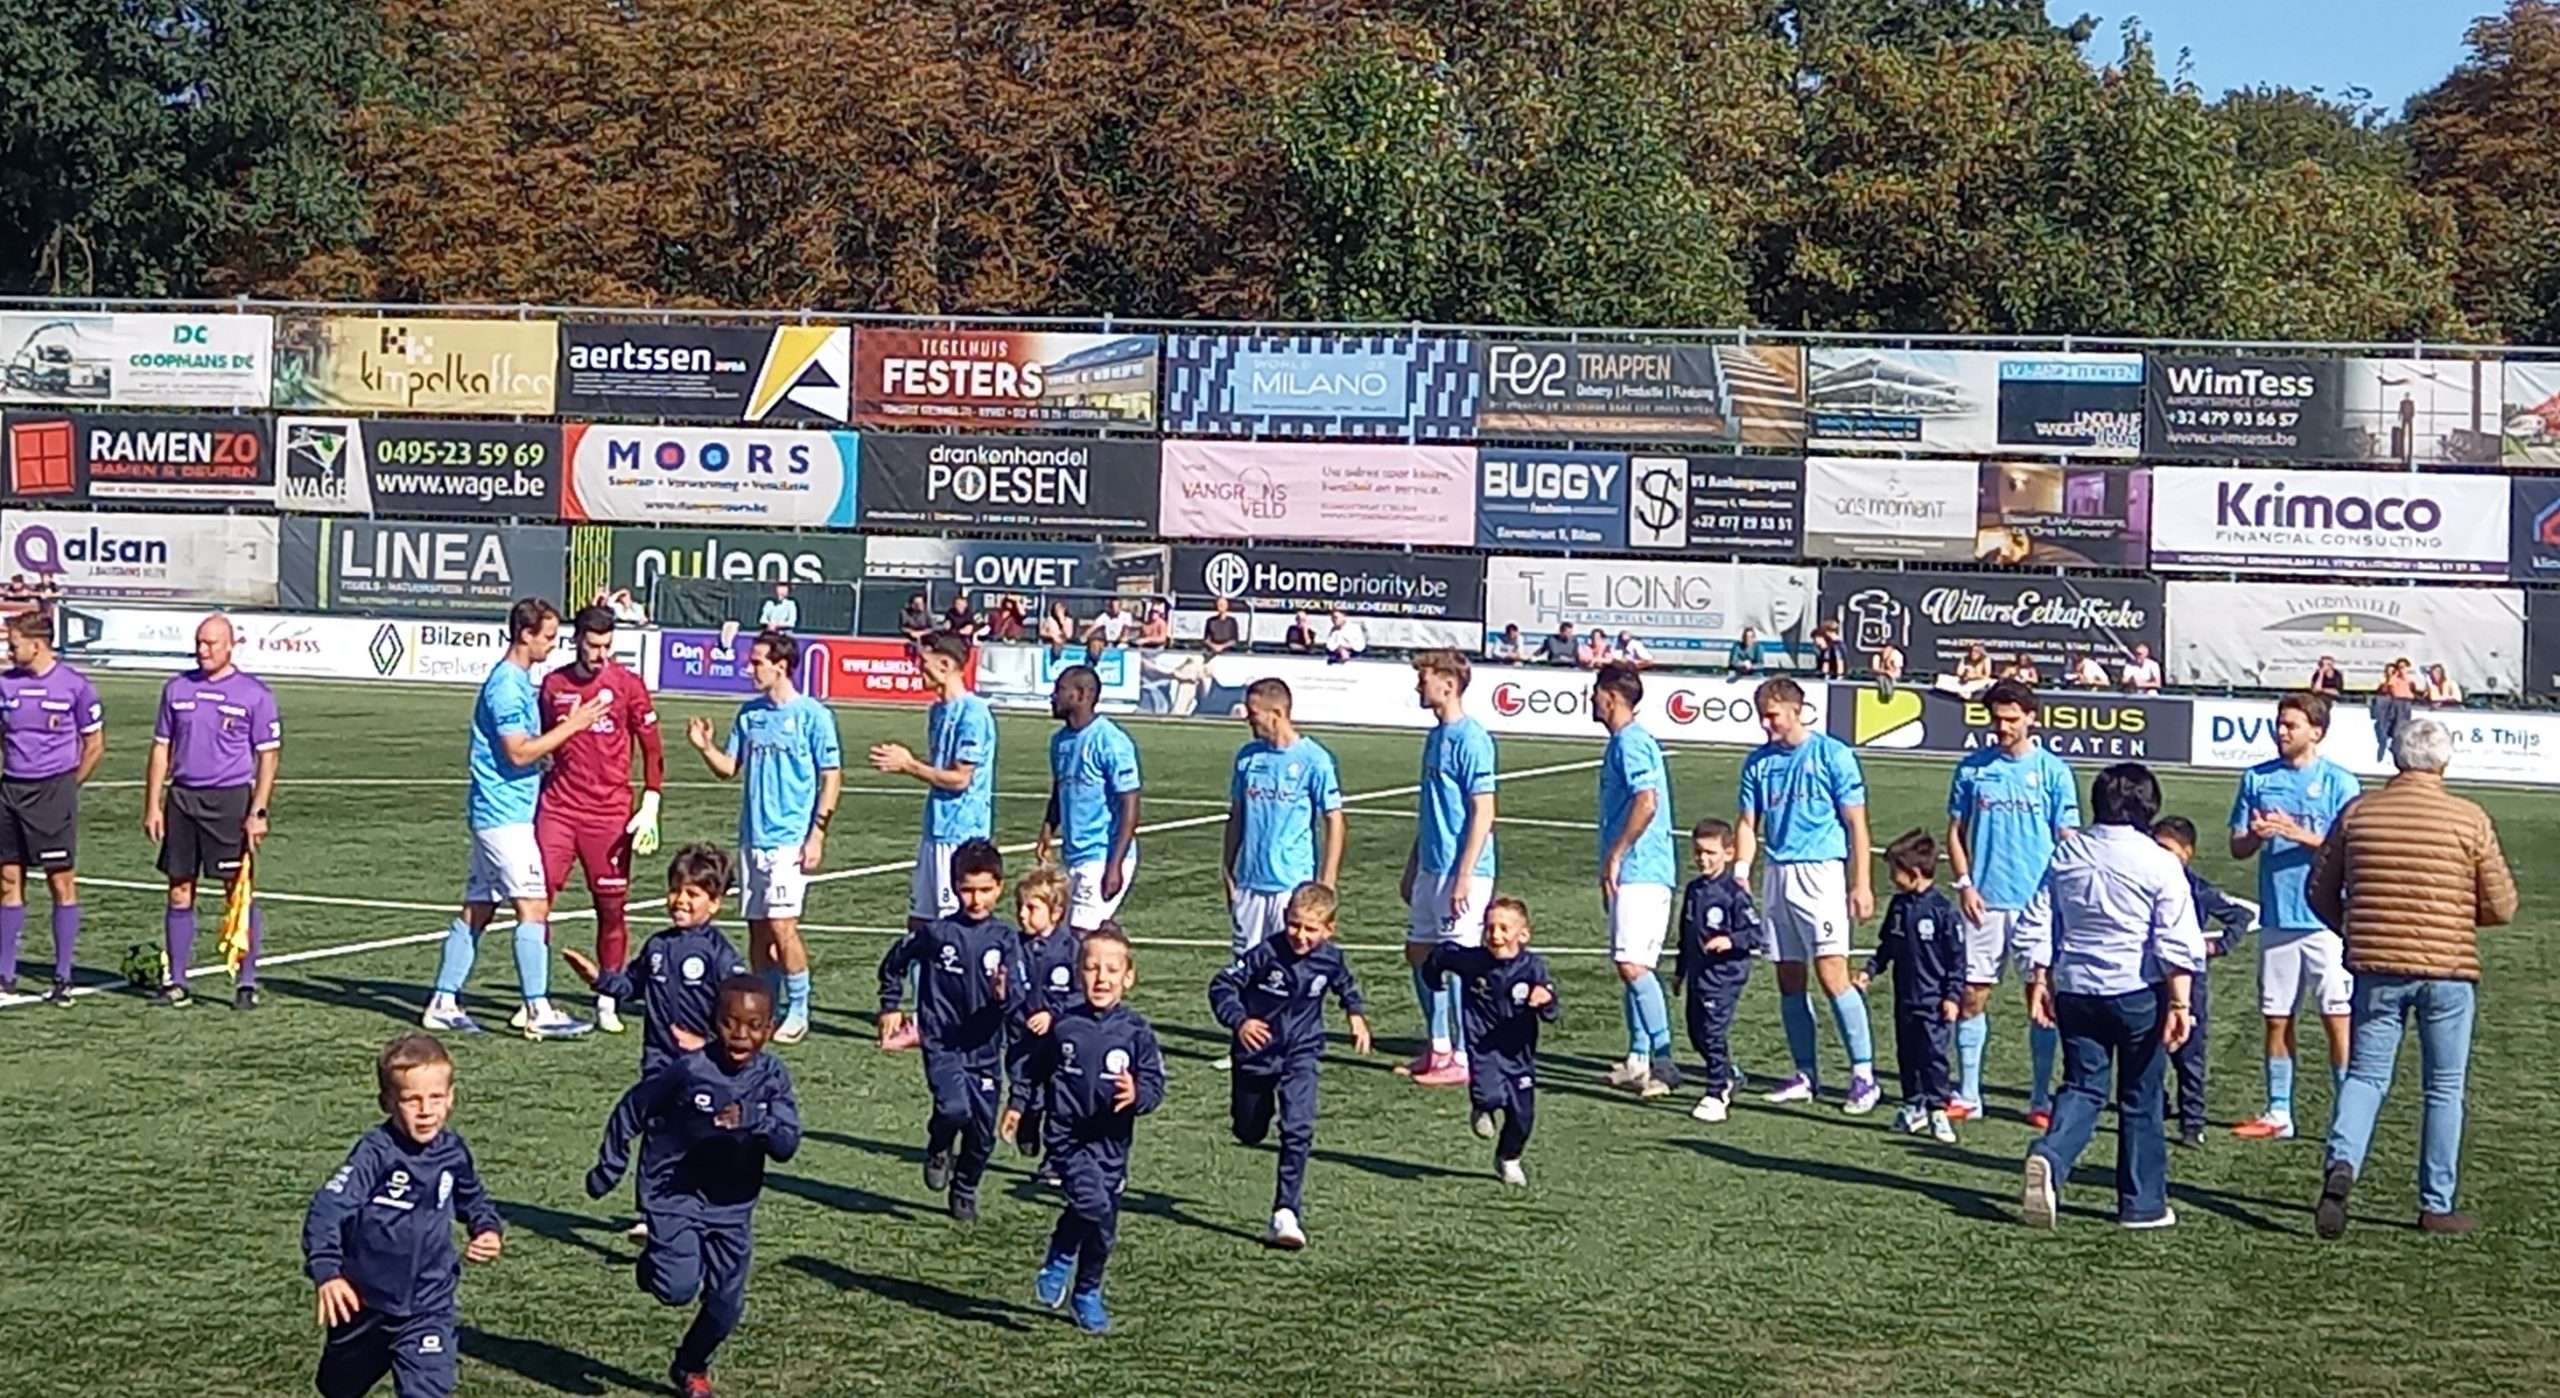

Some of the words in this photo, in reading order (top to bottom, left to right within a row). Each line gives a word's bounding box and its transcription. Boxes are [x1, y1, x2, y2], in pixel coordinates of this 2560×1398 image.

[174, 325, 208, 344] DC
[921, 338, 1009, 358] TEGELHUIS
[130, 354, 228, 369] COOPMANS
[569, 342, 711, 372] aertssen
[1577, 353, 1672, 381] TRAPPEN
[882, 358, 1045, 398] FESTERS
[1253, 371, 1388, 397] MILANO
[2167, 366, 2315, 397] WimTess
[2199, 411, 2231, 426] 479
[2233, 412, 2253, 427] 93
[90, 430, 260, 465] RAMENZO
[377, 440, 472, 466] 0495-23
[477, 443, 508, 466] 59
[513, 444, 545, 467] 69
[607, 440, 810, 474] MOORS
[929, 444, 1088, 466] drankenhandel
[90, 463, 156, 478] RAMEN
[181, 465, 257, 479] DEUREN
[376, 470, 545, 501] www.wage.be
[928, 465, 1088, 505] POESEN
[1484, 461, 1619, 501] BUGGY
[285, 475, 348, 500] WAGE
[1240, 501, 1287, 519] VELD
[2217, 481, 2442, 533] Krimaco
[64, 527, 167, 564] alsan
[2216, 530, 2314, 545] FINANCIAL
[2321, 532, 2443, 548] CONSULTING
[341, 529, 511, 583] LINEA
[954, 555, 1080, 587] LOWET
[1254, 563, 1448, 598] Homepriority.be
[1605, 574, 1712, 610] ICING
[421, 626, 490, 648] Bilzen
[1492, 681, 1590, 717] Geot
[1666, 689, 1819, 726] Geoc
[1964, 703, 2146, 733] BISIUS
[1822, 919, 1834, 938] 9
